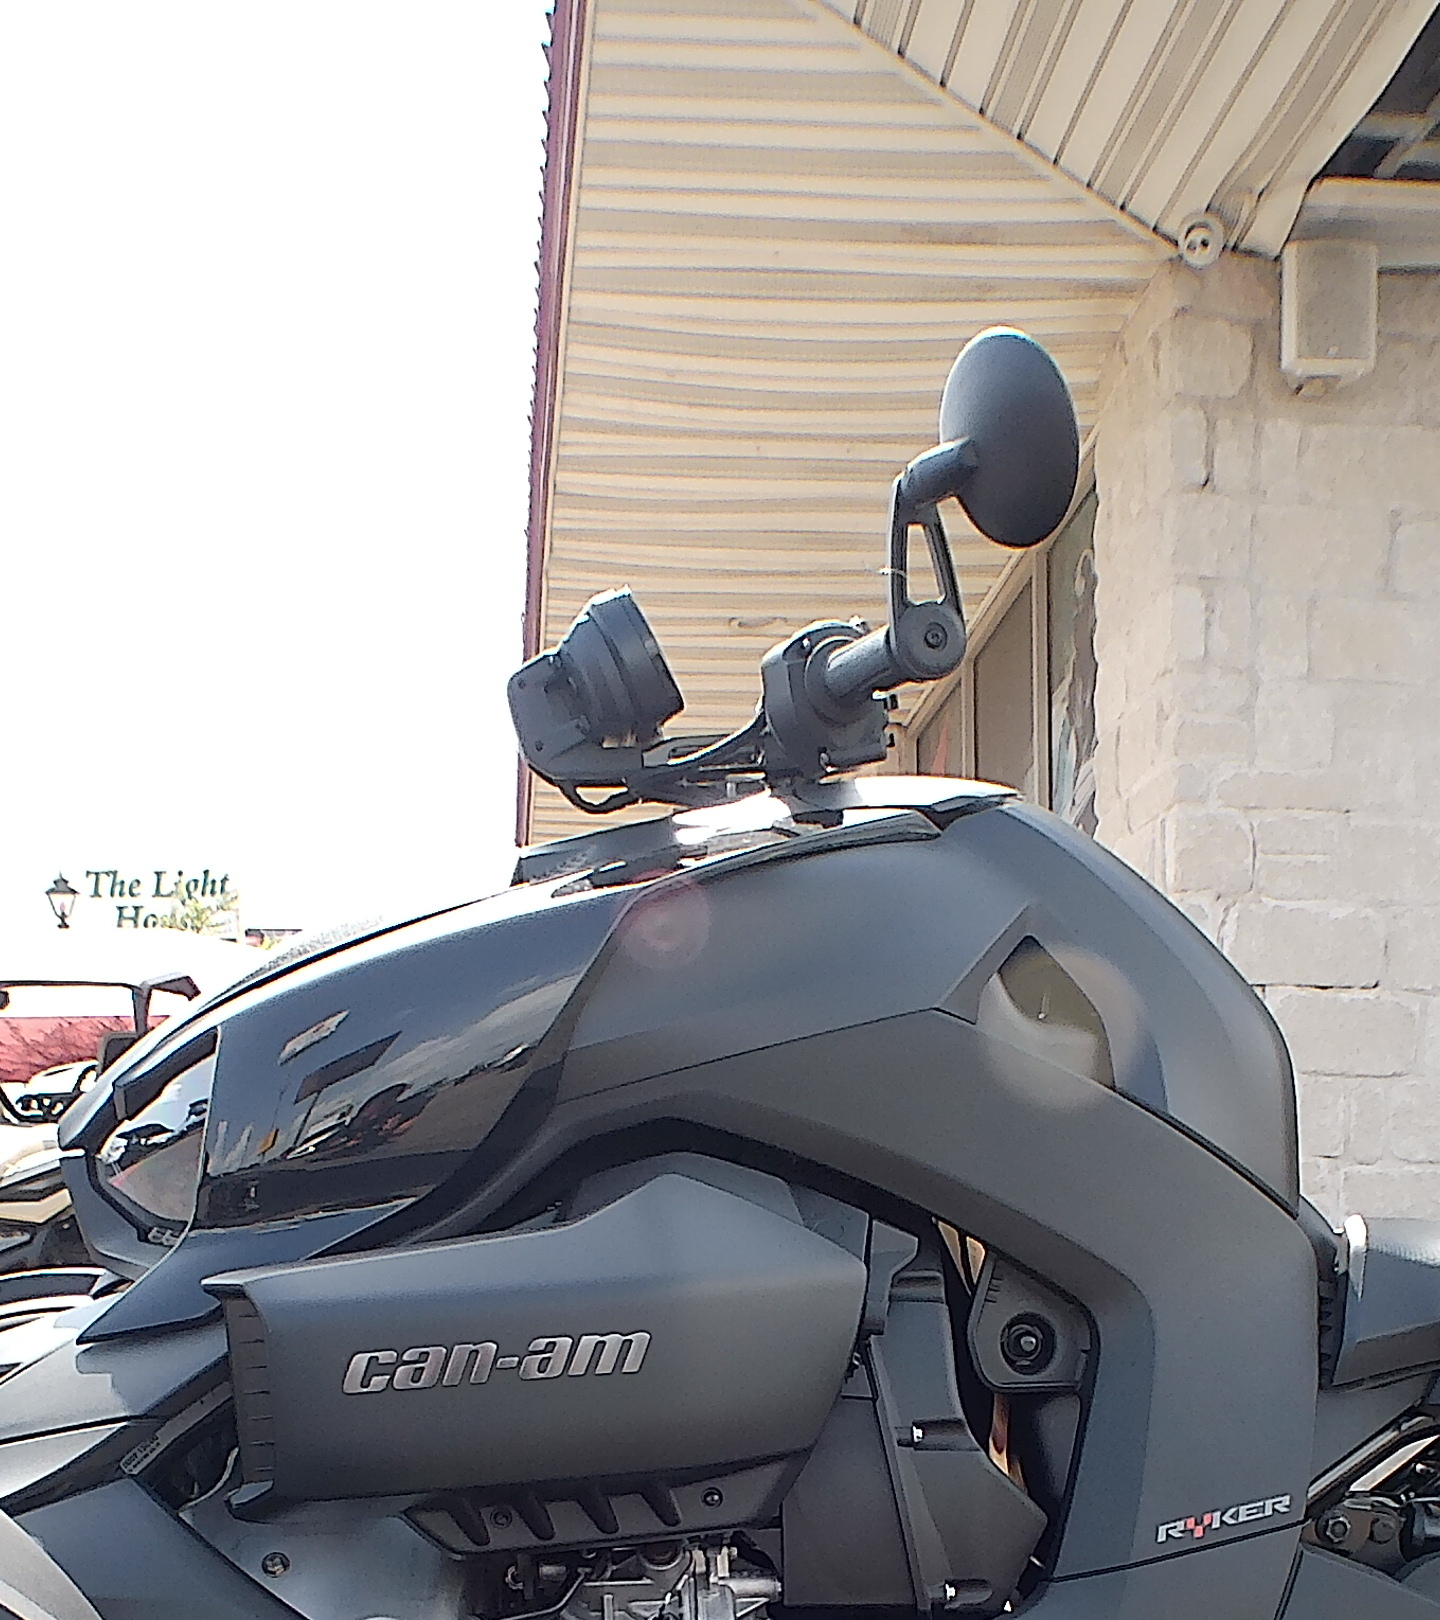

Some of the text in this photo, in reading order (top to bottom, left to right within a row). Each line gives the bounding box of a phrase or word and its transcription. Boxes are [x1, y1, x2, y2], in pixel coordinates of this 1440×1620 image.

[85, 868, 230, 905] The Light
[342, 1329, 652, 1395] can-am
[1156, 1494, 1292, 1543] RYKER
